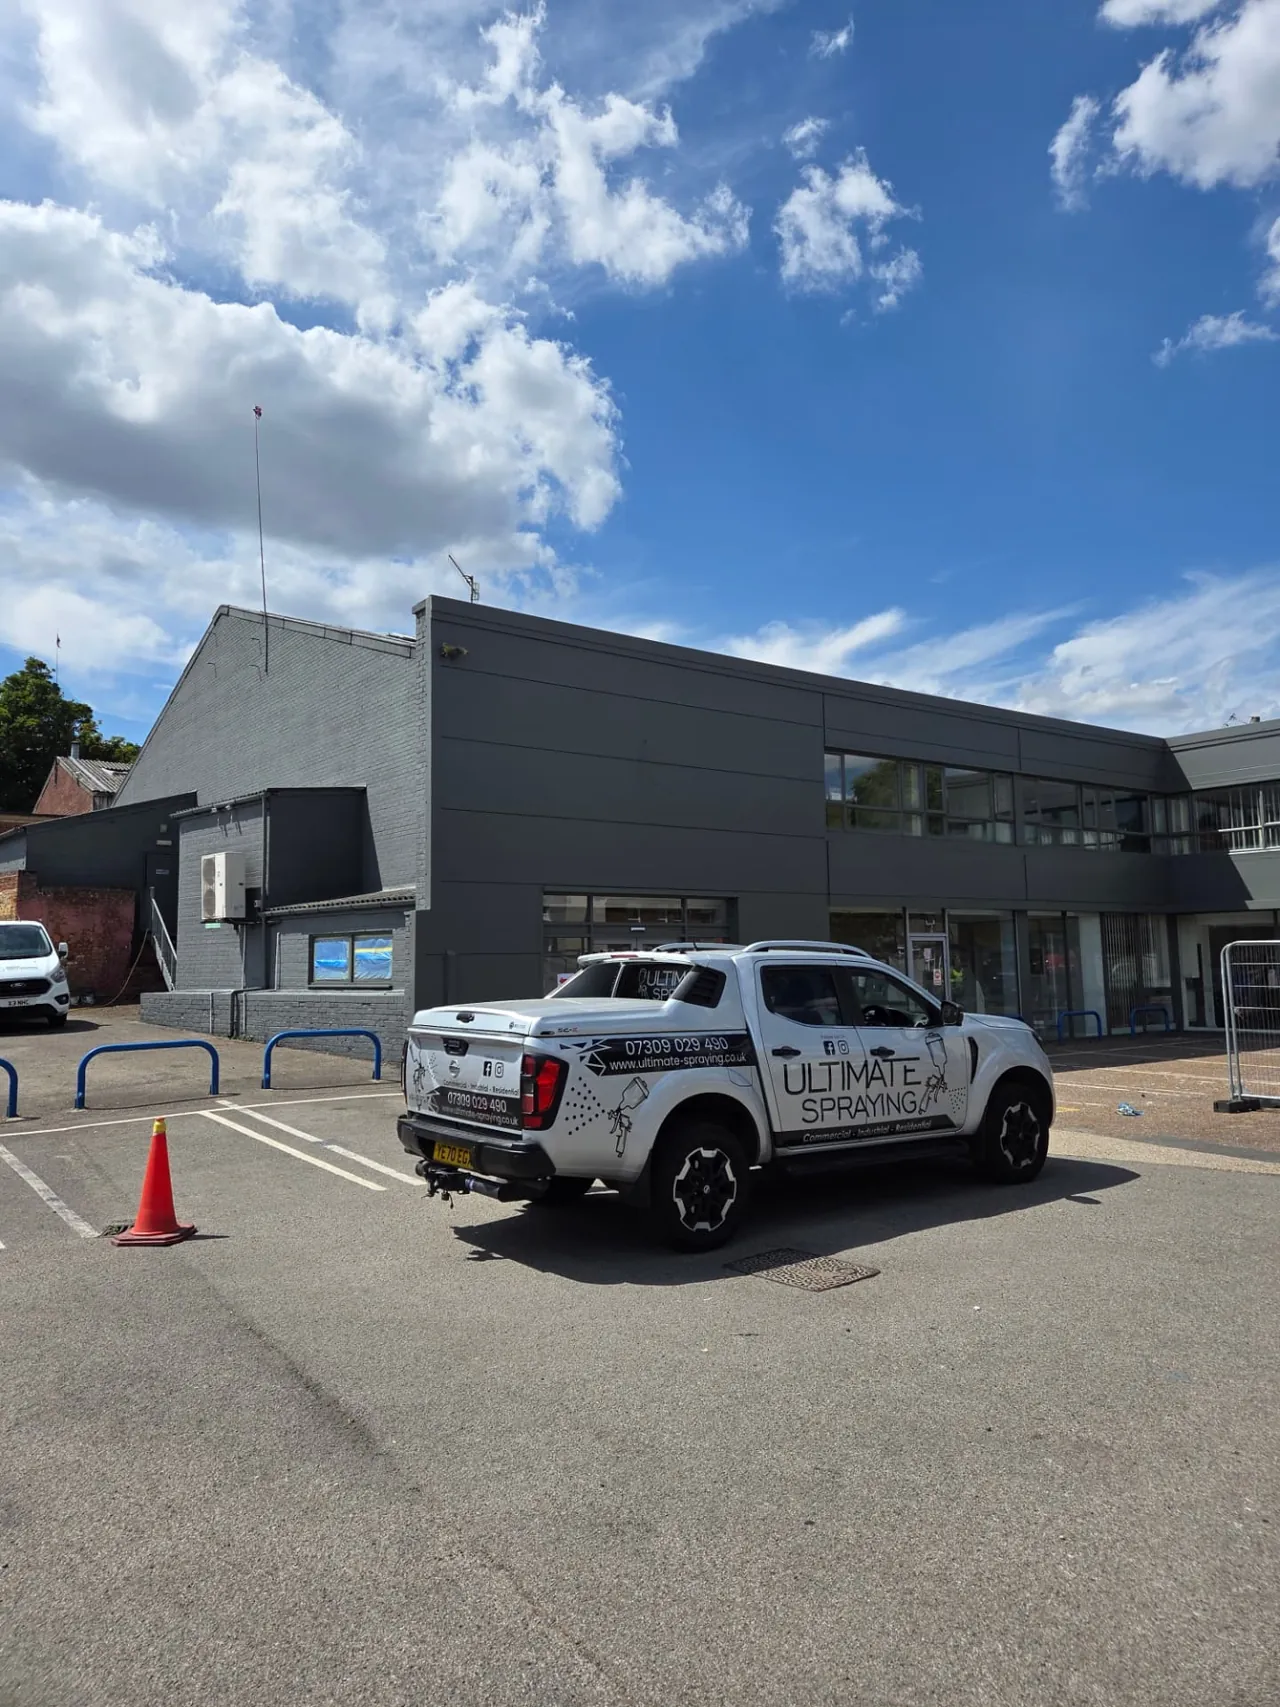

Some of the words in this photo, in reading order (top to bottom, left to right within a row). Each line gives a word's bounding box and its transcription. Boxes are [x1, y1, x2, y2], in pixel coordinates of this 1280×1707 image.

[625, 1039, 671, 1055] 07309
[674, 1037, 701, 1052] 029
[704, 1037, 729, 1051] 490
[609, 1053, 747, 1070] www.ultimate-spraying.co.uk
[783, 1057, 921, 1095] ULTIMATE
[447, 1091, 471, 1107] 07309
[472, 1096, 488, 1110] 029
[489, 1099, 507, 1113] 490
[802, 1091, 917, 1123] SPRAYING
